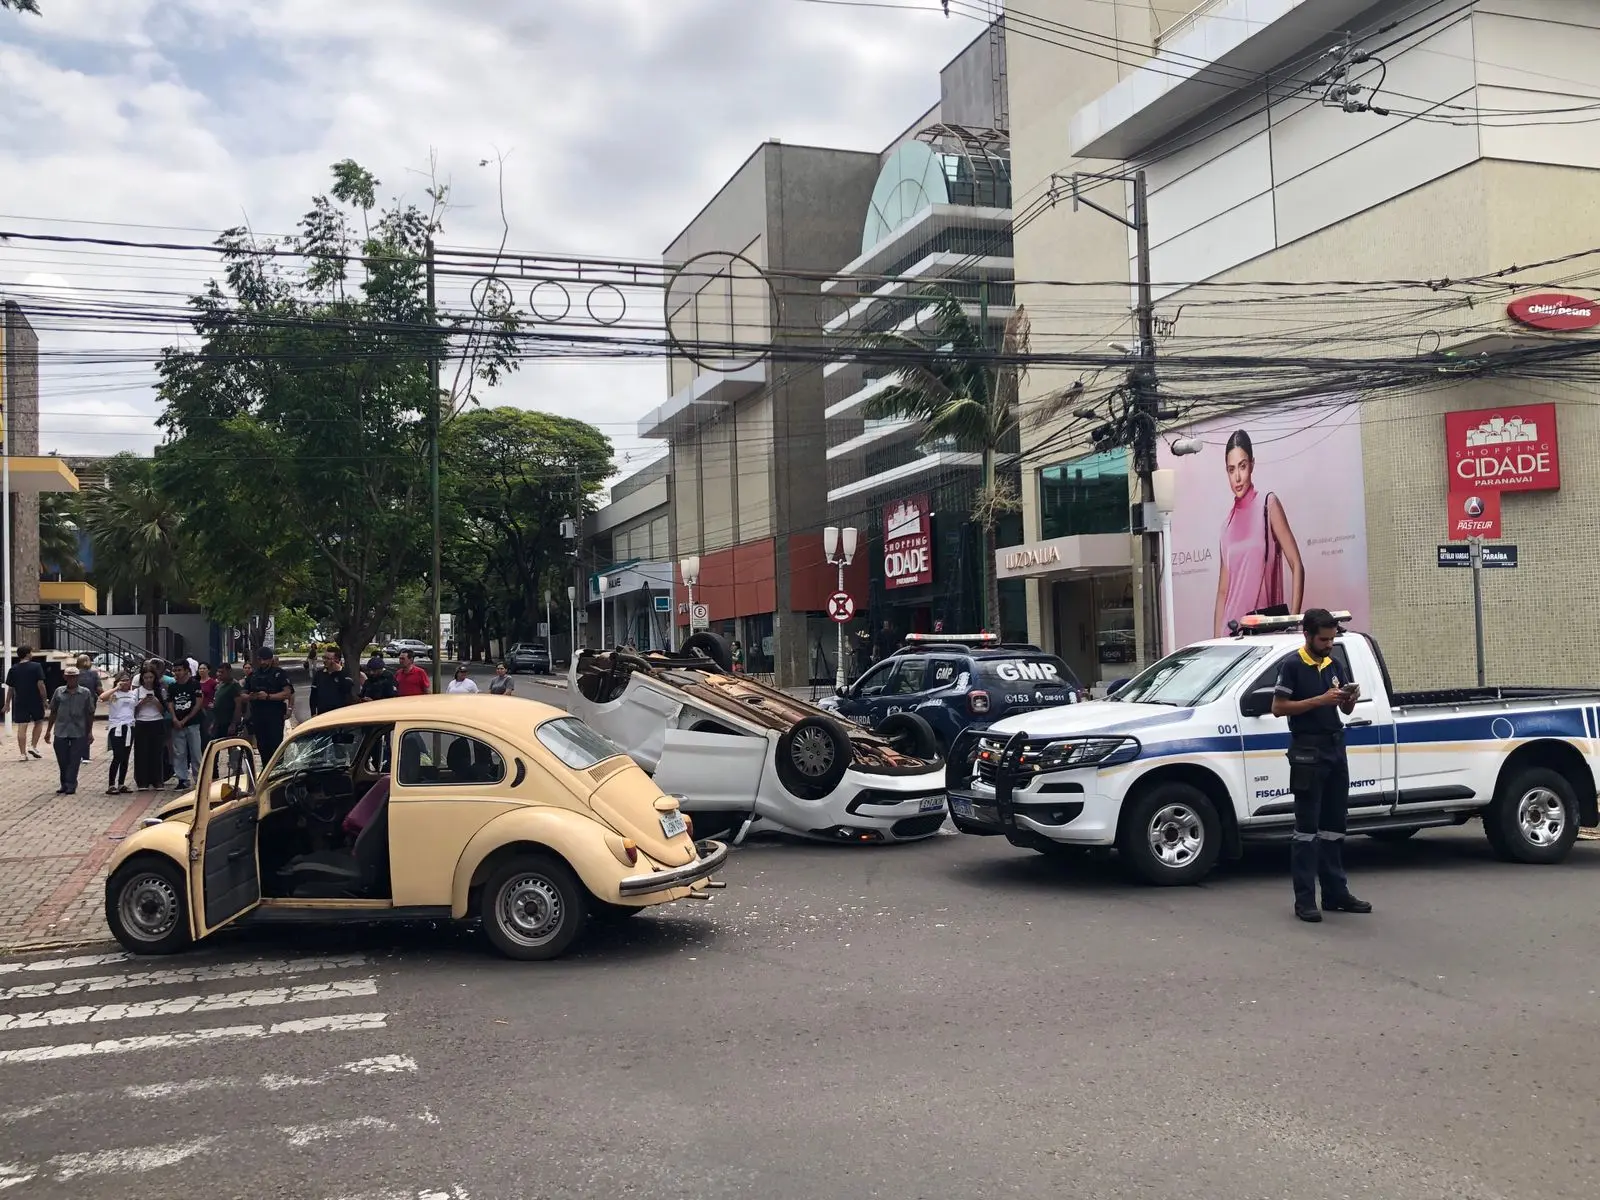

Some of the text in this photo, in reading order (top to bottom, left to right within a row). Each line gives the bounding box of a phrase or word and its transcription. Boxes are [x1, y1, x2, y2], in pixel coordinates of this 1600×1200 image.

[1456, 443, 1549, 458] SHOPPING
[1456, 452, 1551, 478] CIDADE
[1456, 520, 1493, 530] PASTEUR
[884, 536, 928, 553] SHOPPING
[884, 547, 928, 578] CIDADE
[1482, 552, 1508, 560] PARAÍBA
[936, 668, 953, 680] GMP
[996, 662, 1058, 681] GMP
[1013, 694, 1029, 703] 153
[1217, 724, 1239, 735] 001
[1255, 779, 1376, 798] FISCALI NSITO
